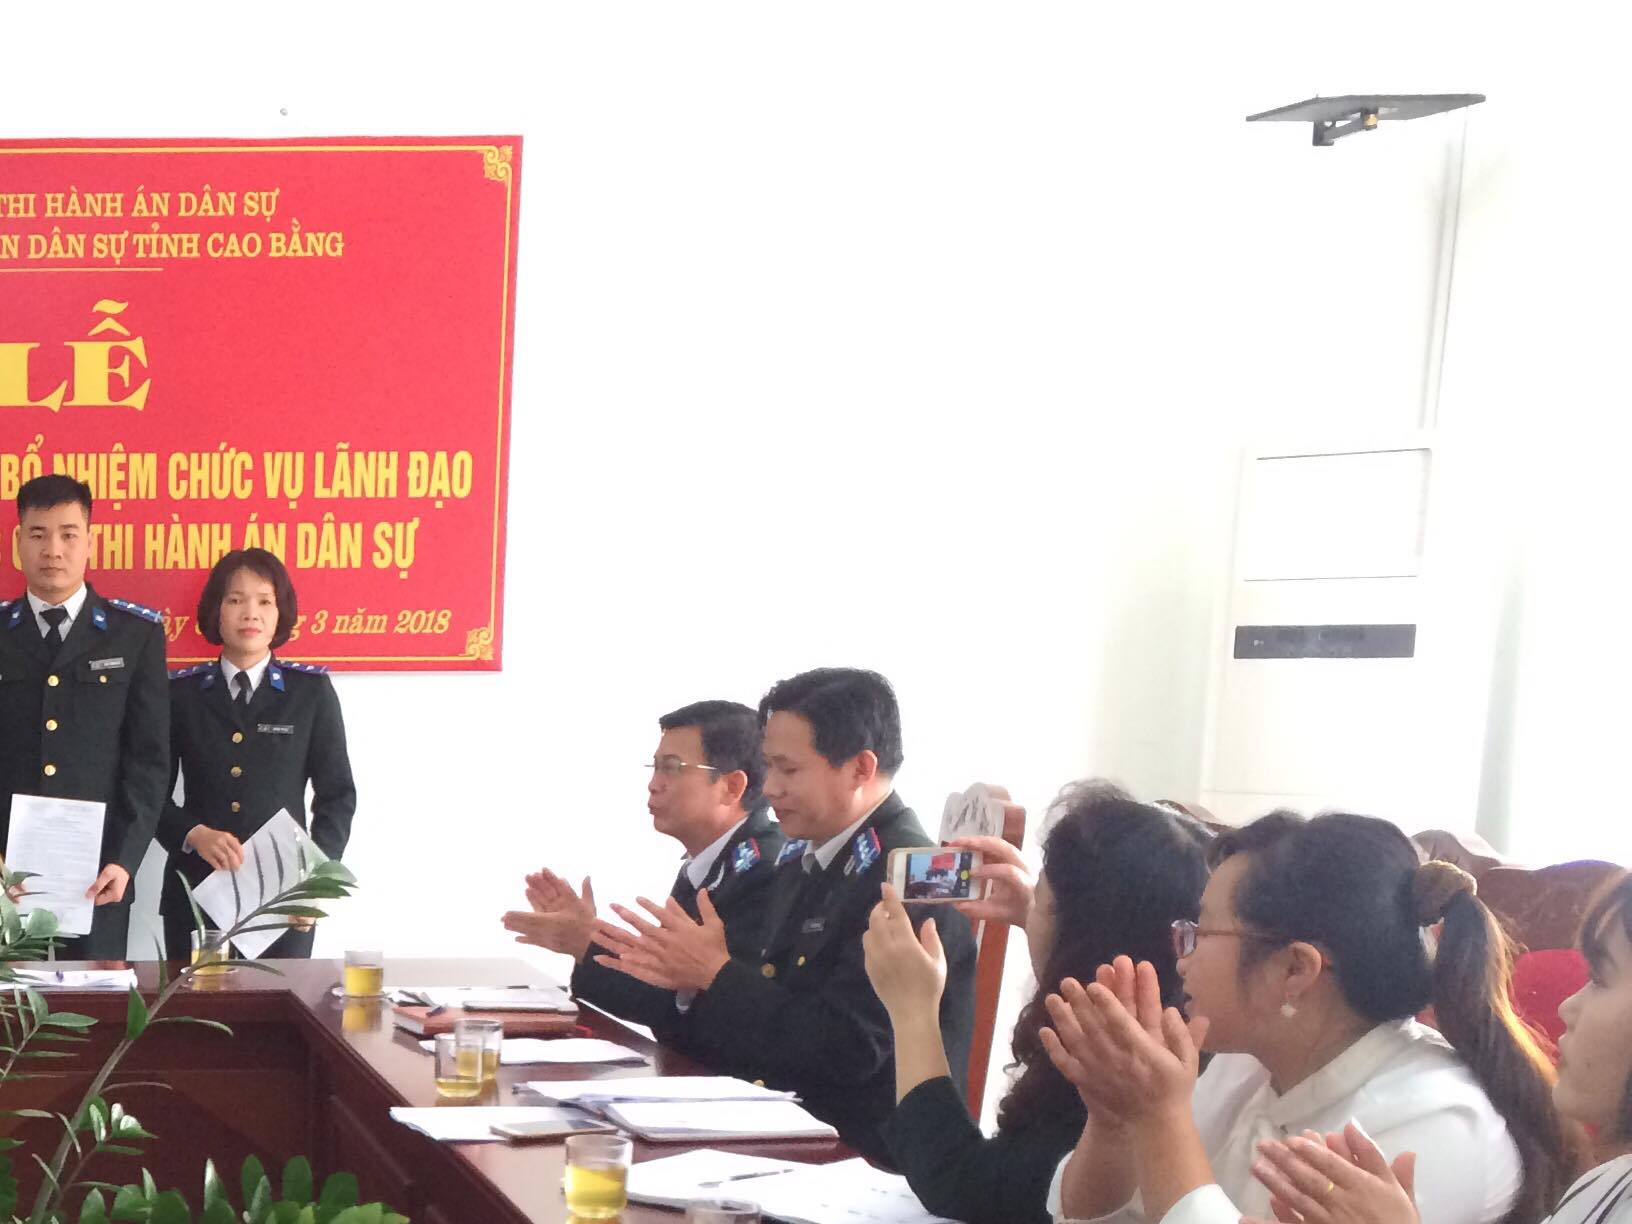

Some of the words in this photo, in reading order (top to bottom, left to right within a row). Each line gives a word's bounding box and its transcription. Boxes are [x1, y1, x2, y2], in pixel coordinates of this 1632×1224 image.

[44, 185, 124, 218] HÀNH
[131, 184, 171, 218] ÁN
[177, 184, 237, 217] DÂN
[243, 188, 280, 222] SỰ
[28, 226, 86, 259] DÂN
[92, 231, 129, 264] SỰ
[132, 222, 201, 259] TỈNH
[206, 232, 263, 258] CAO
[269, 217, 345, 258] BẰNG
[0, 434, 44, 501] BỔ
[167, 441, 254, 501] CHỨC
[263, 451, 305, 510] VỤ
[313, 441, 399, 499] LÃNH
[406, 449, 474, 509] ĐẠO
[86, 523, 134, 570] THI
[144, 512, 232, 570] HÀNH
[295, 511, 363, 569] DÂN
[371, 516, 421, 580] SỰ
[310, 609, 329, 635] 3
[332, 607, 389, 635] năm
[393, 609, 452, 635] 2018
